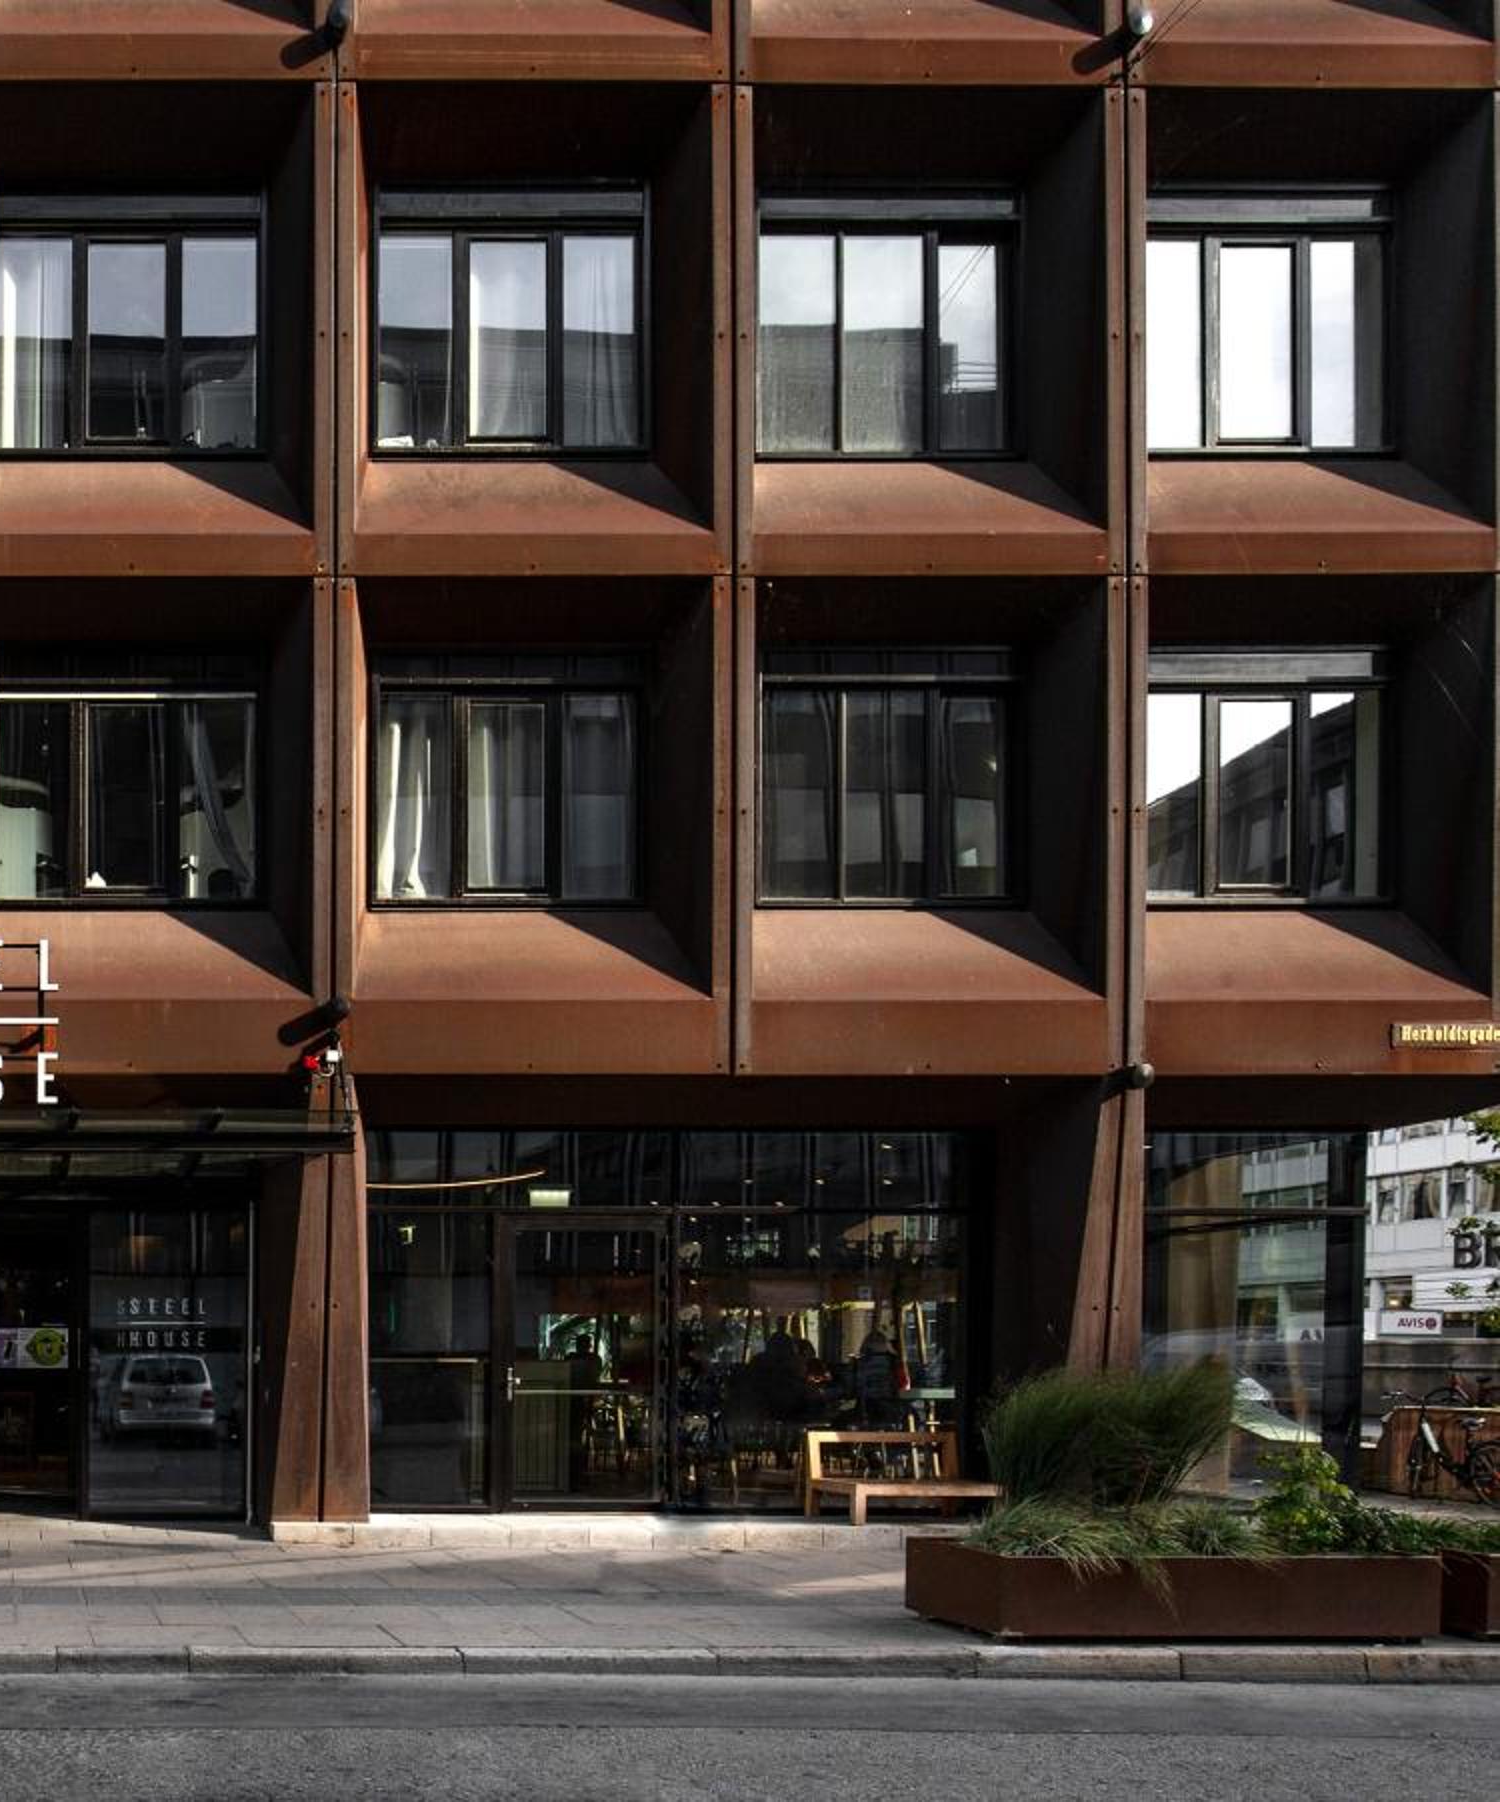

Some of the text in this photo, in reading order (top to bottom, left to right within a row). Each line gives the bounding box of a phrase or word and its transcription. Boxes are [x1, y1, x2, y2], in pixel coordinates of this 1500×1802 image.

[129, 1297, 207, 1315] STEEL
[1397, 1317, 1426, 1329] AVIS
[129, 1330, 206, 1348] HOUSE
